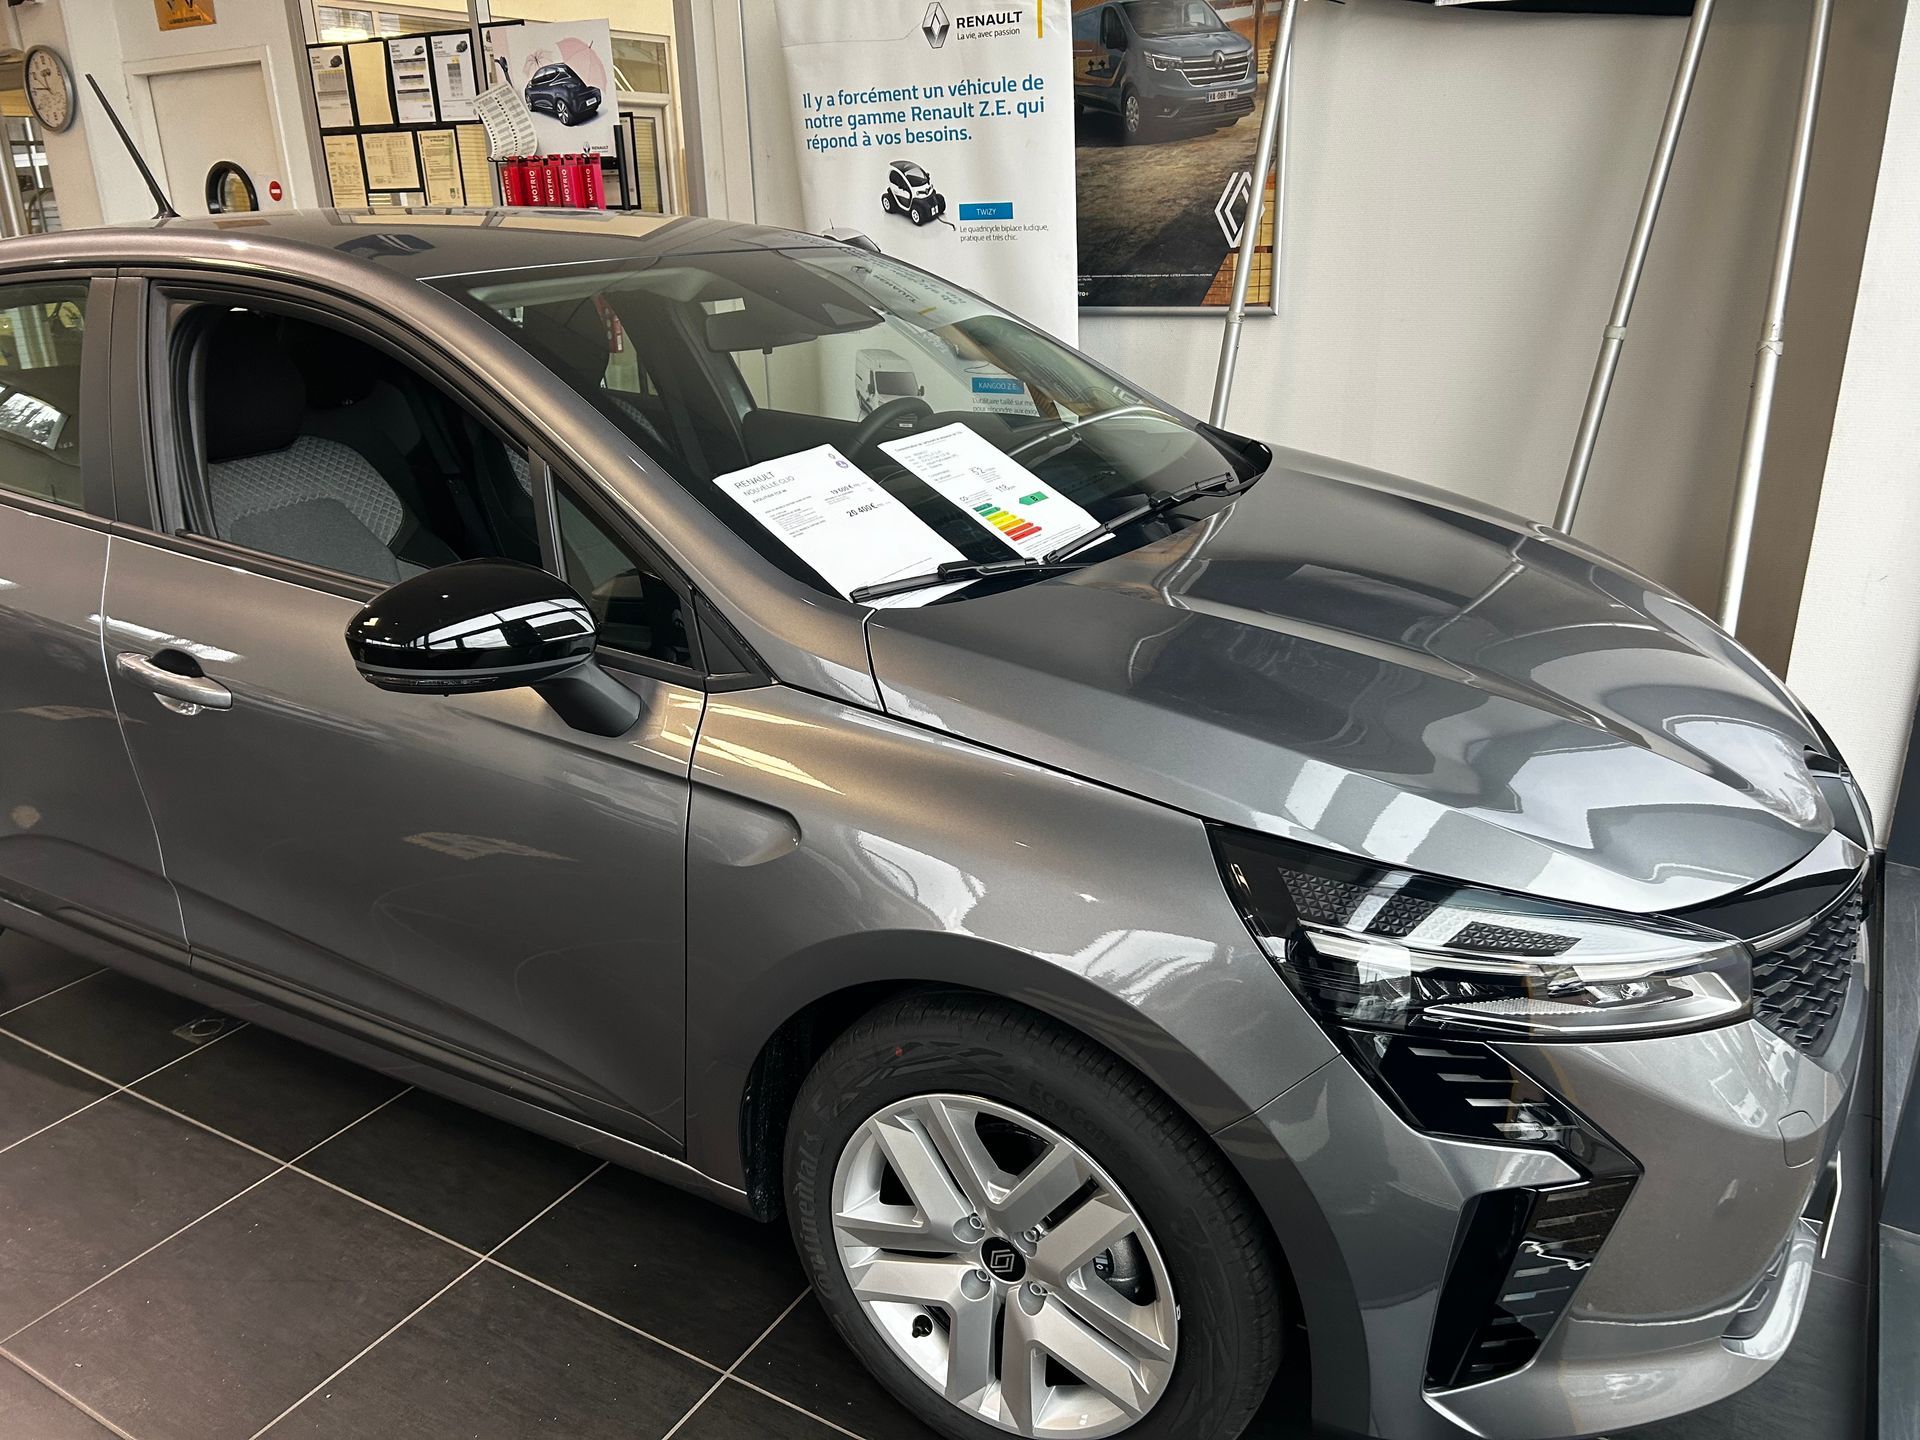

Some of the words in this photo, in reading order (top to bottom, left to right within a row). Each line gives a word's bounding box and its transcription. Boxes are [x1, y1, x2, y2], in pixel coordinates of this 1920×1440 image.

[956, 11, 1022, 29] RENAULT
[957, 32, 965, 40] La
[966, 31, 977, 40] vie,
[978, 30, 992, 38] avec
[994, 27, 1020, 38] passion
[803, 93, 812, 109] Il
[814, 95, 824, 112] y
[826, 94, 835, 107] a
[838, 84, 919, 106] forcément
[923, 85, 944, 99] un
[948, 76, 1017, 97] véhicule
[1022, 74, 1044, 91] de
[805, 111, 843, 129] notre
[847, 109, 906, 131] gamme
[911, 102, 974, 122] Renault
[979, 100, 1011, 117] Z.E.
[1016, 96, 1045, 118] qui
[806, 133, 858, 153] répond
[862, 131, 871, 147] à
[875, 132, 901, 146] vos
[905, 125, 972, 145] besoins.
[503, 170, 513, 202] MOTRIO
[528, 170, 539, 202] MOTRIO
[546, 169, 555, 202] MOTRIO
[562, 168, 570, 202] MOTRIO
[585, 168, 594, 201] MOTRIO
[975, 208, 997, 216] TWIZY
[978, 381, 1007, 390] KANGOO
[734, 471, 775, 489] RENAULT
[743, 480, 780, 496] NOUVELLE
[792, 1147, 832, 1300] Continental
